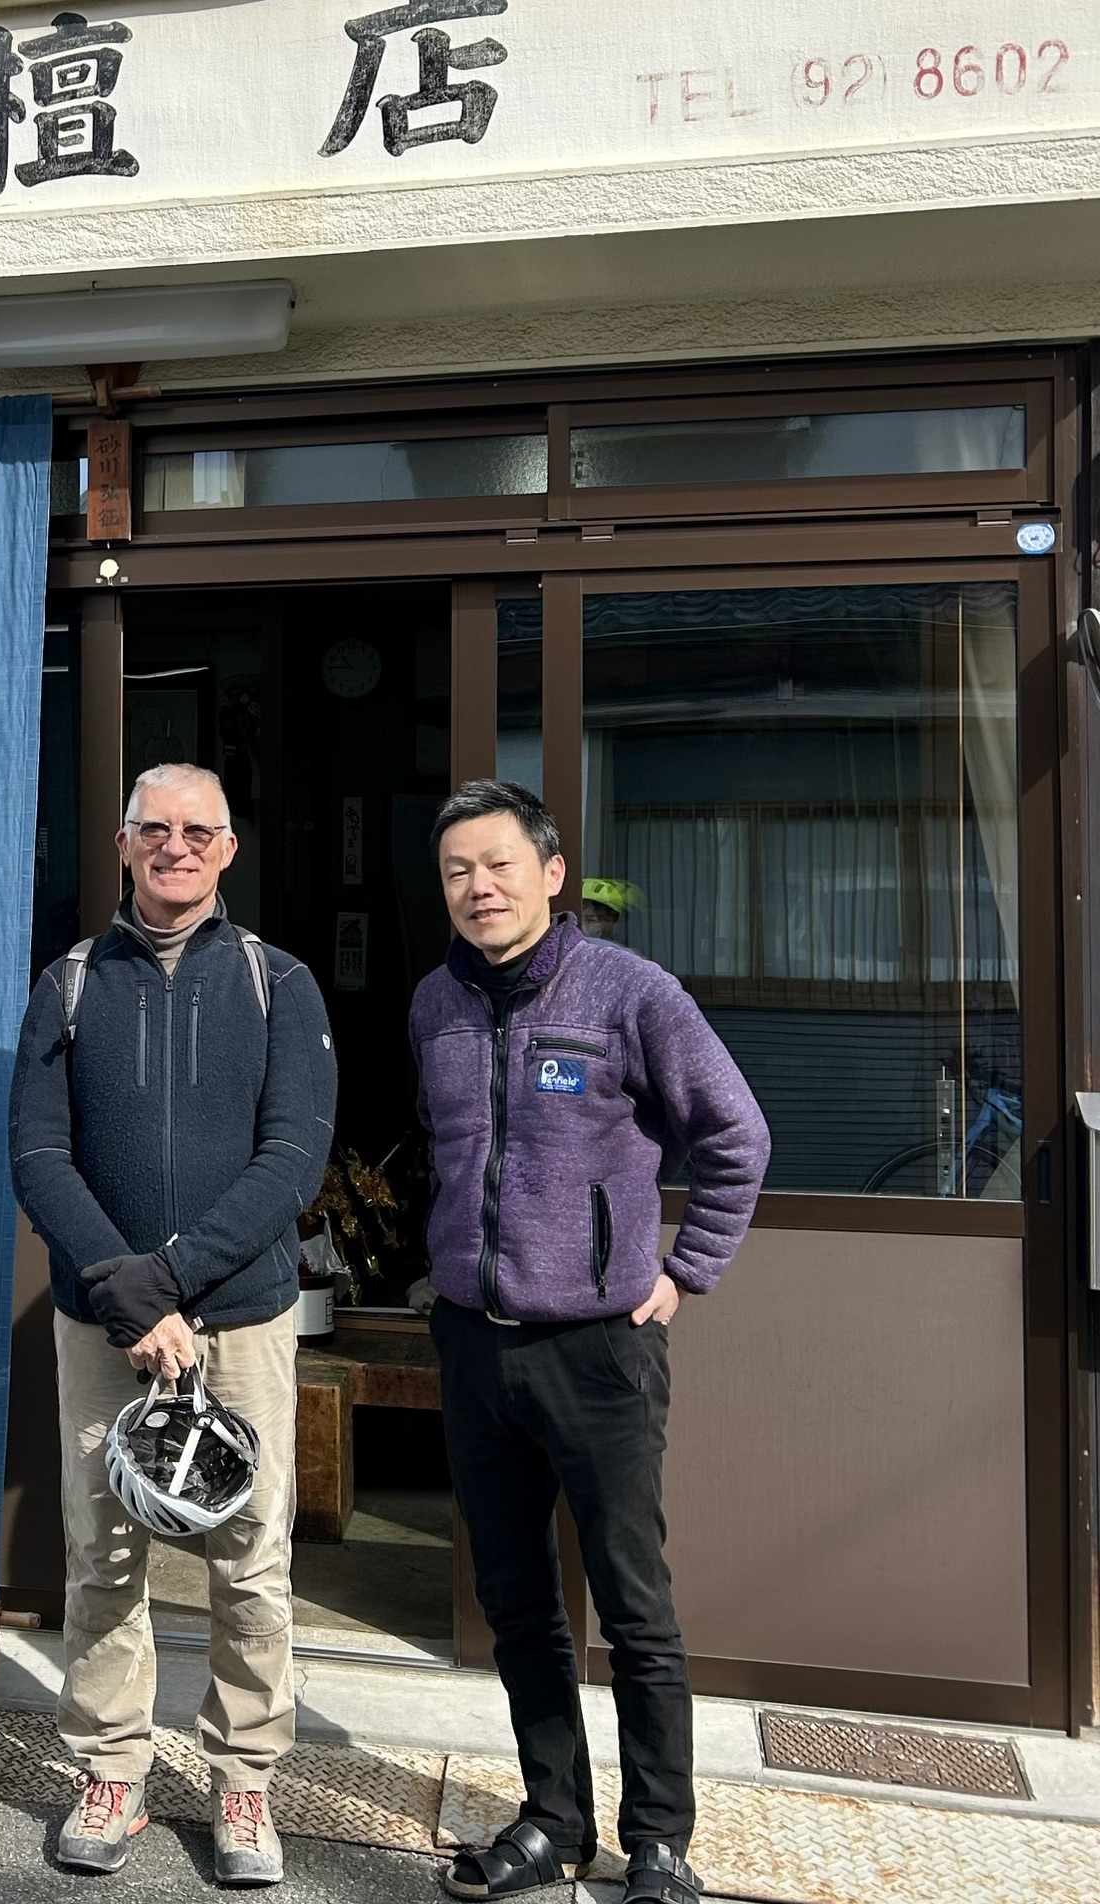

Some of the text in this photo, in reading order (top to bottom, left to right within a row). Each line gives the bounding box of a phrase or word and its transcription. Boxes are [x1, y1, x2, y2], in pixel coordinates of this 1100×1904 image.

[636, 39, 1071, 124] TEL (92) 8602
[541, 1060, 577, 1086] Penfield
